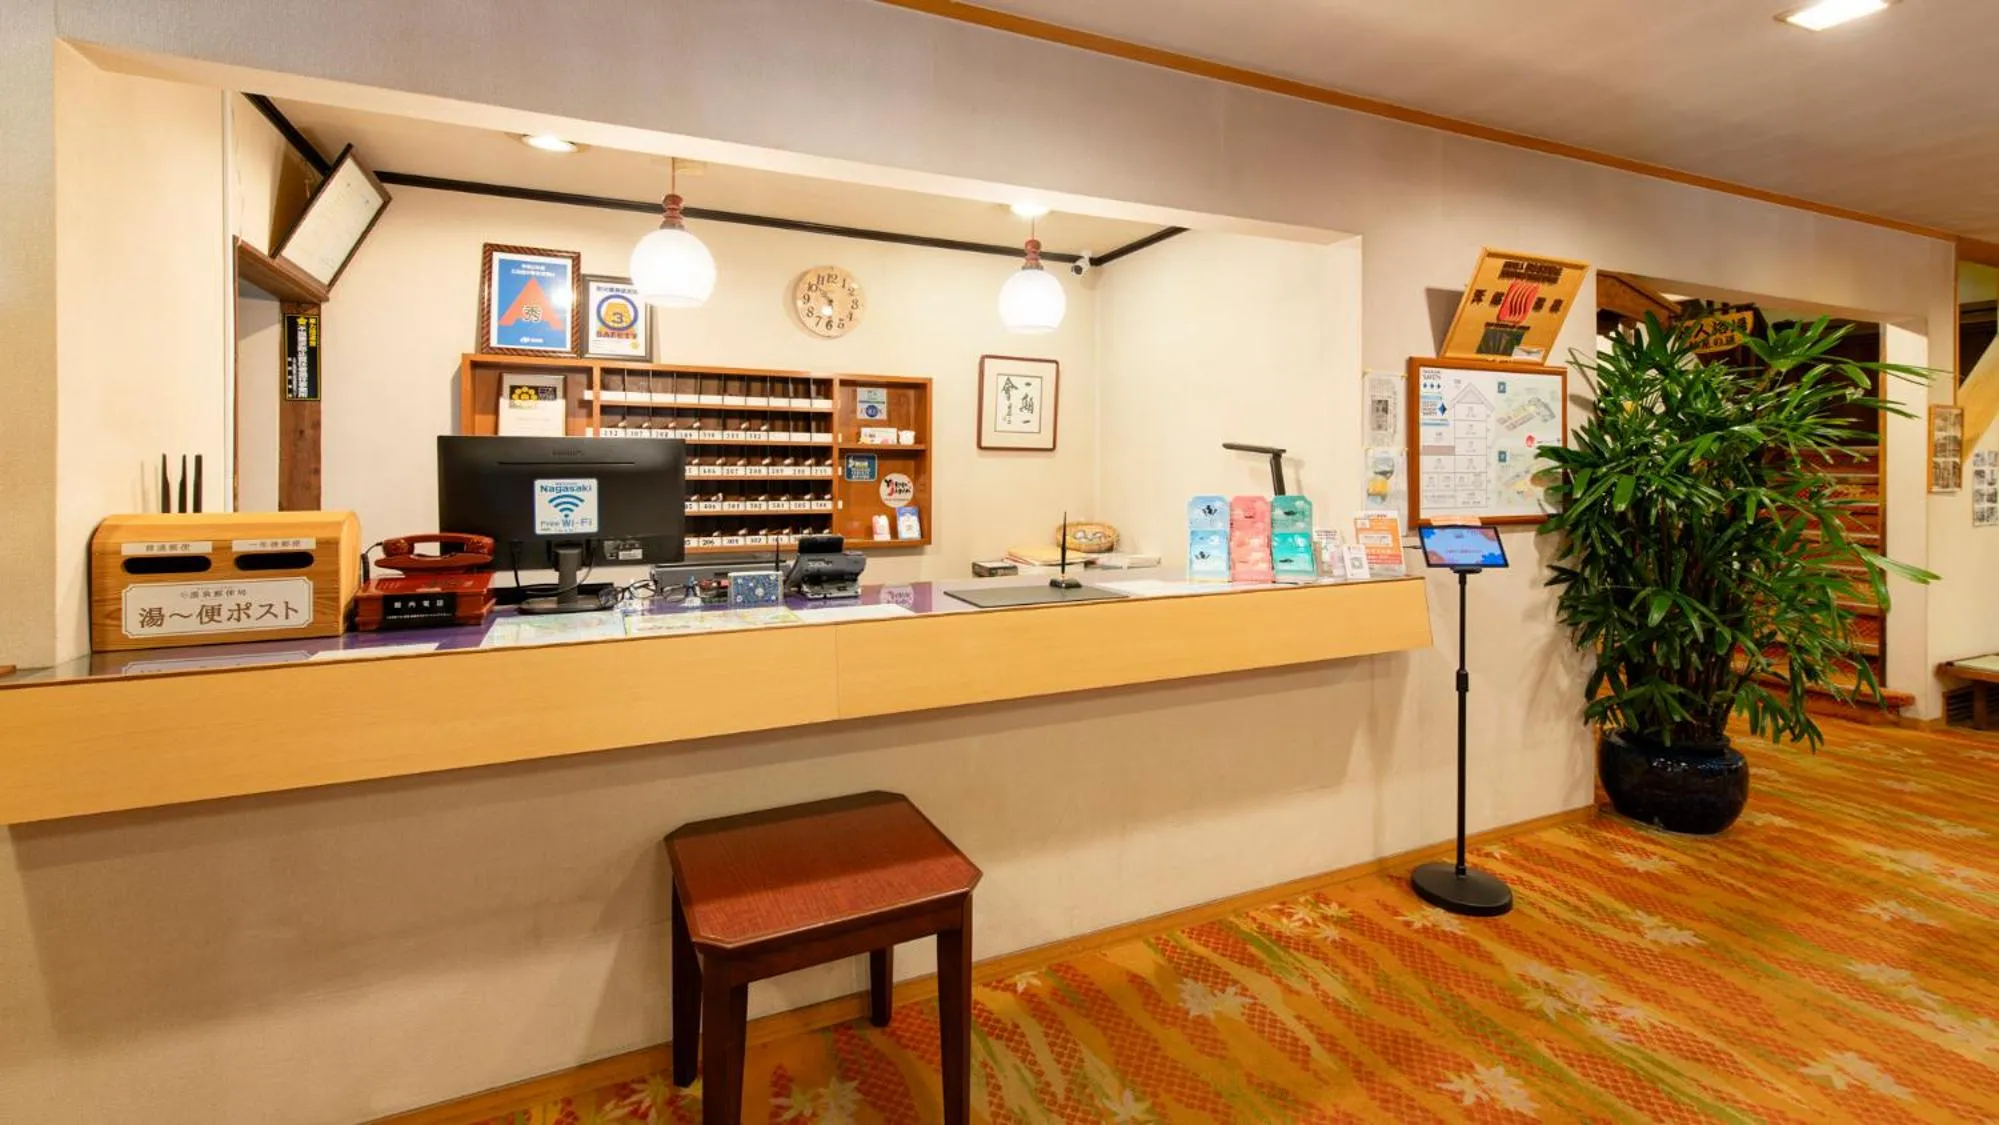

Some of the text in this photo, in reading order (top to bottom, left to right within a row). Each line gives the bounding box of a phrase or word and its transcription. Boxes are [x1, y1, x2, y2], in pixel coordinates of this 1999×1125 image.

[521, 304, 541, 323] 秀
[611, 311, 624, 325] 3
[825, 319, 833, 331] 6
[540, 485, 592, 493] Nagasaki
[562, 518, 593, 527] Wi-Fi
